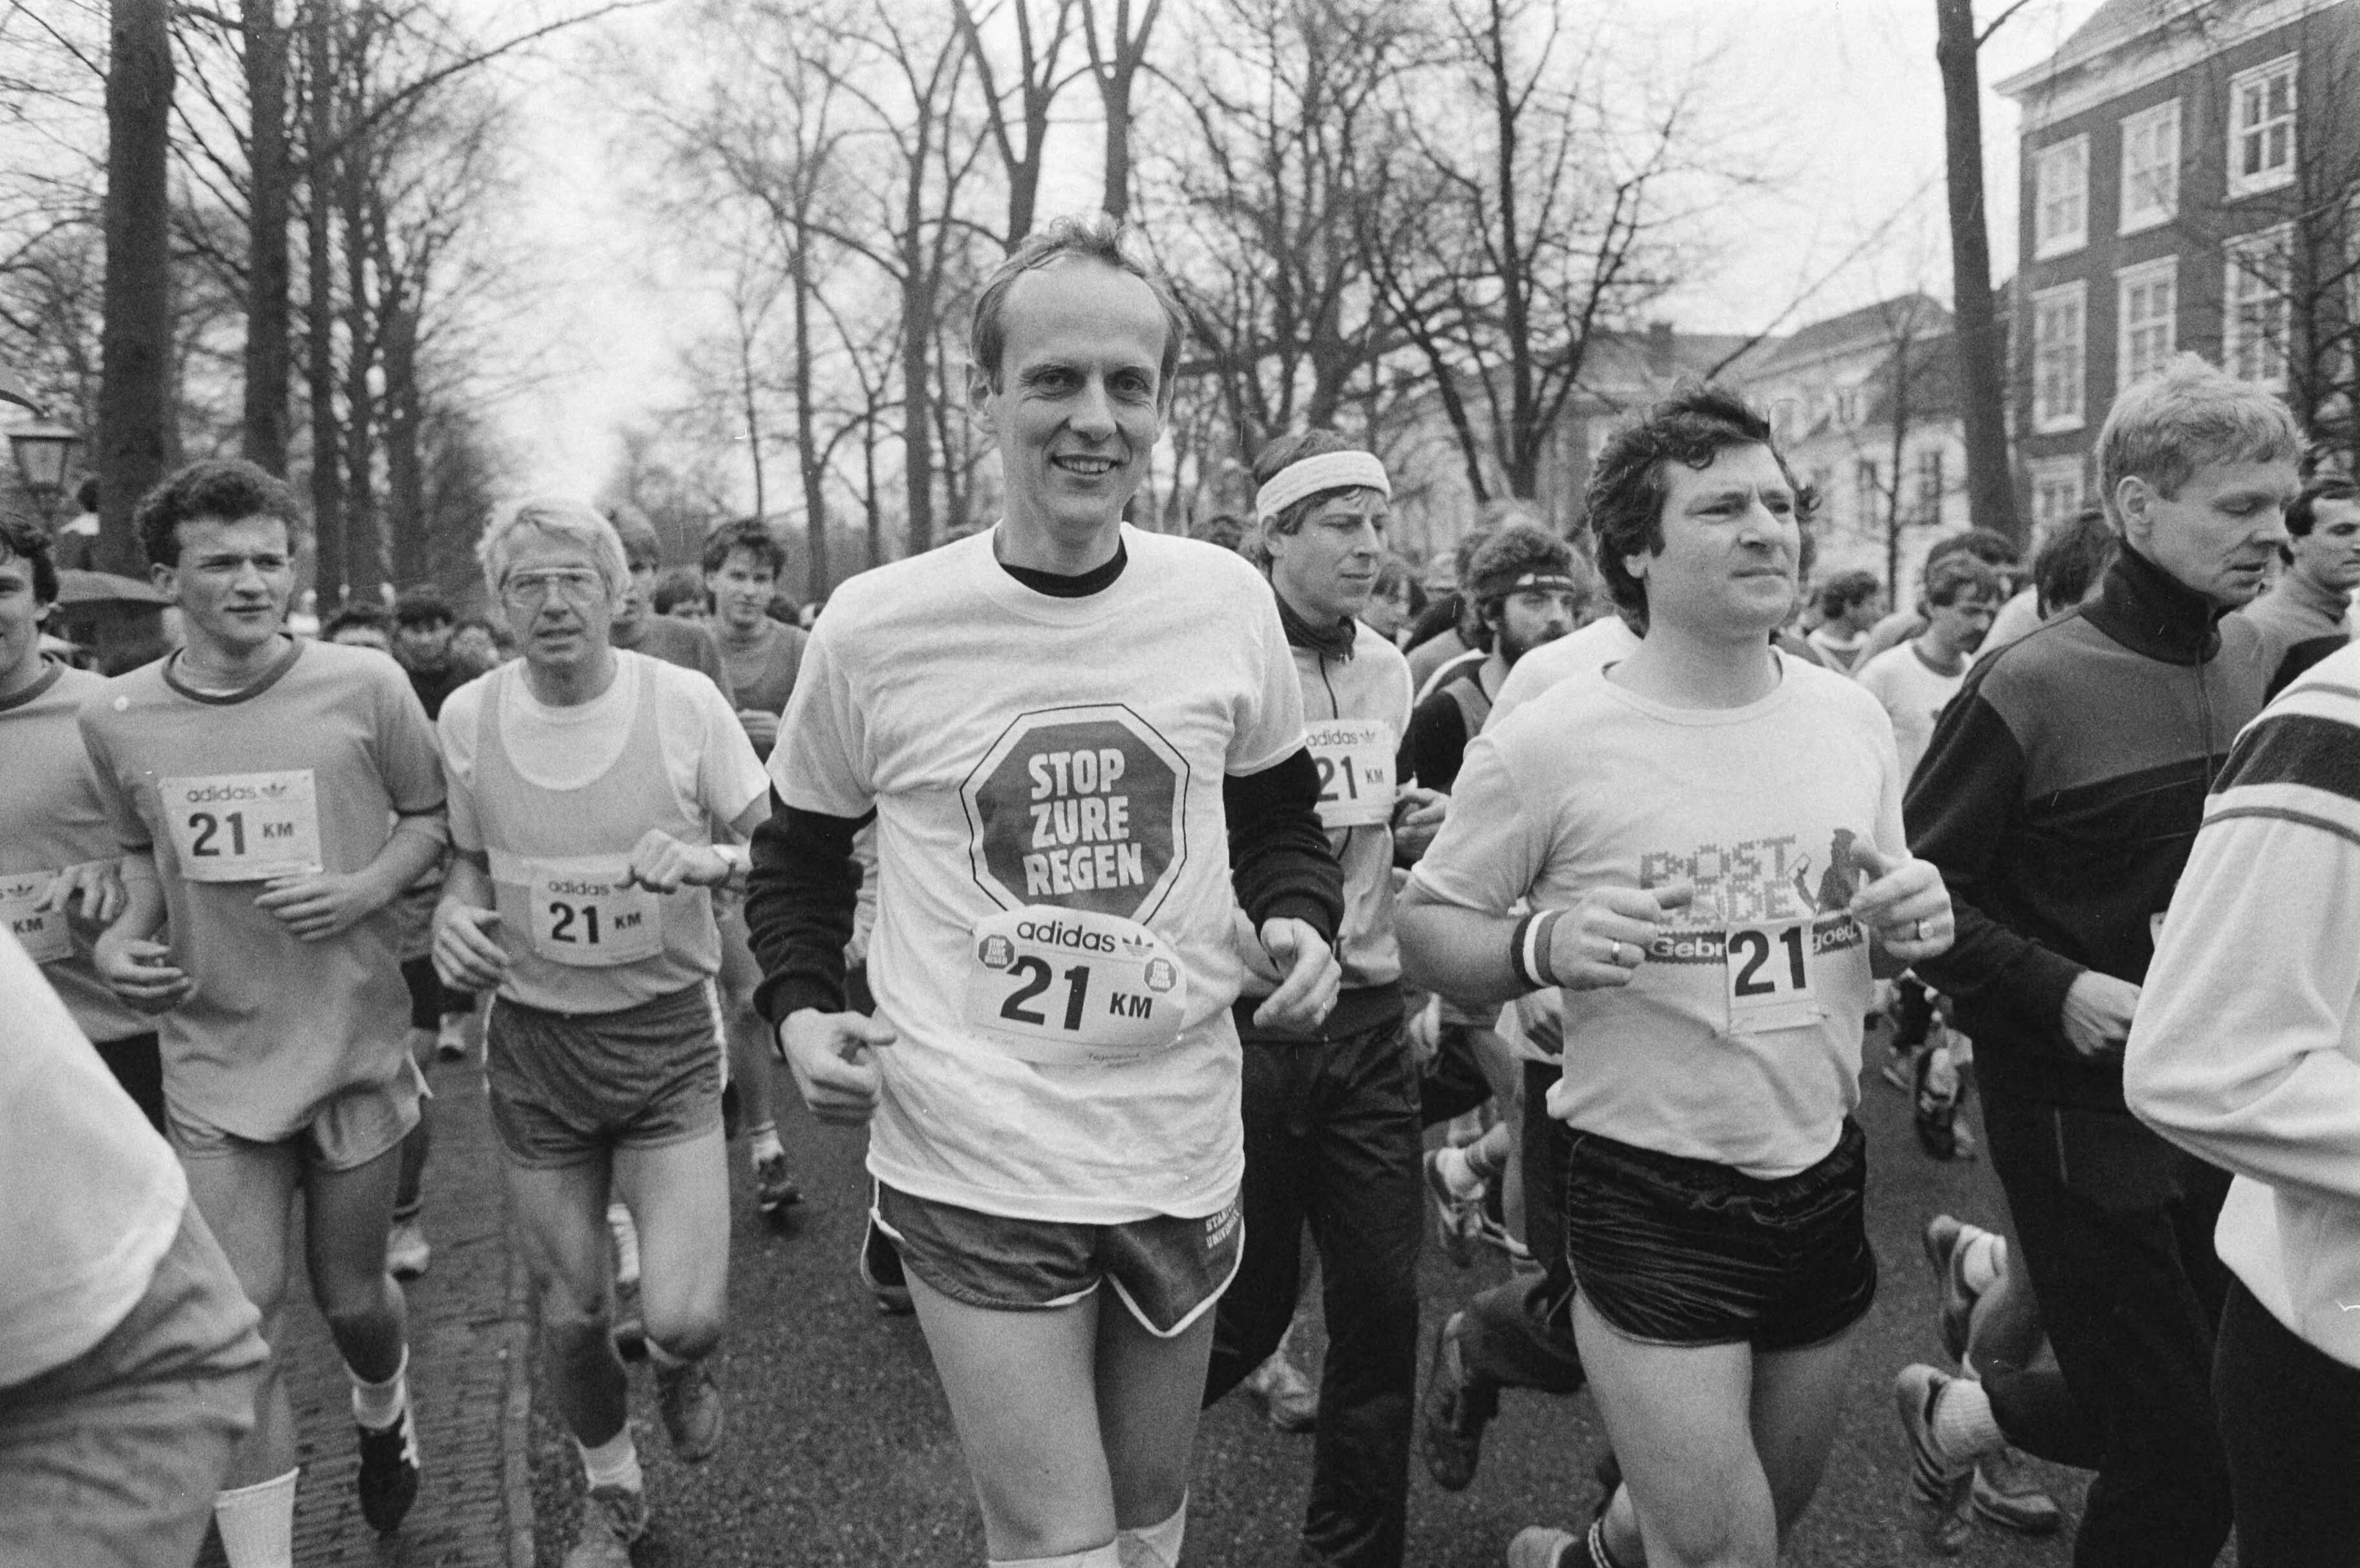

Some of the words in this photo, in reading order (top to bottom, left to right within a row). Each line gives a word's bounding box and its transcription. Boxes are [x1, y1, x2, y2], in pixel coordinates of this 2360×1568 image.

[1305, 729, 1358, 747] adidas
[186, 784, 257, 803] adidas
[1028, 747, 1125, 800] STOP
[1313, 755, 1358, 802] 21
[1365, 768, 1384, 784] KM
[188, 811, 246, 857] 21
[262, 821, 295, 839] KM
[1029, 795, 1130, 850] ZURE
[1022, 842, 1144, 896] REGEN
[1639, 834, 1796, 890] POST
[549, 880, 610, 897] adidas
[12, 917, 44, 935] KM
[549, 901, 600, 944] 21
[615, 912, 642, 930] KM
[1017, 920, 1117, 953] adidas
[1728, 925, 1807, 998] 21
[1000, 955, 1090, 1032] 21
[1109, 991, 1154, 1019] KM
